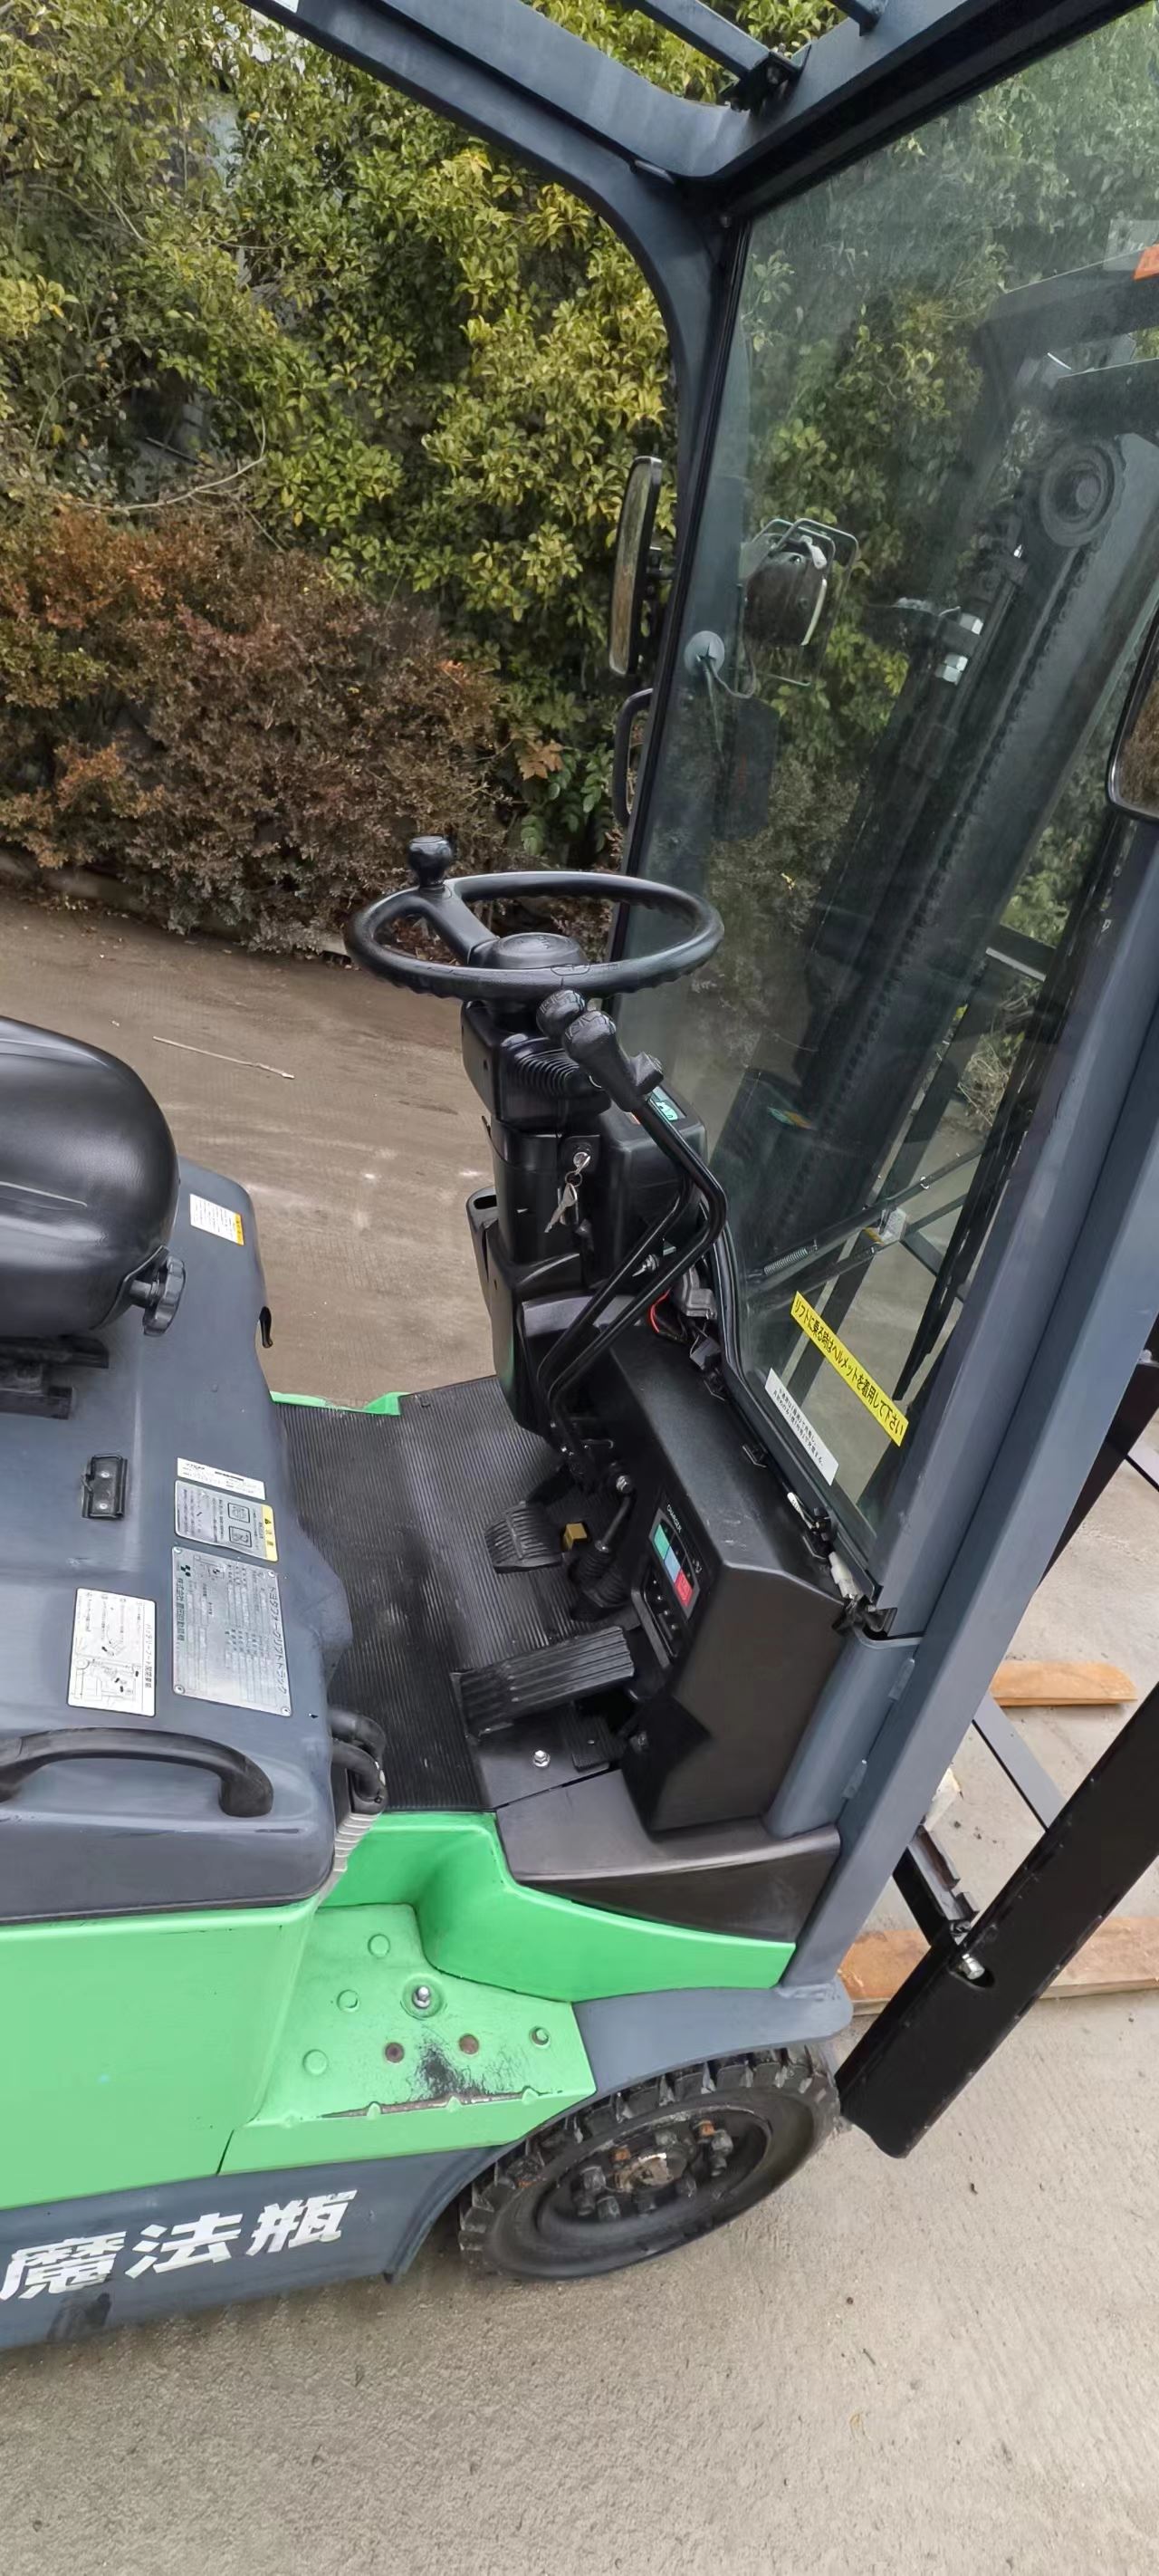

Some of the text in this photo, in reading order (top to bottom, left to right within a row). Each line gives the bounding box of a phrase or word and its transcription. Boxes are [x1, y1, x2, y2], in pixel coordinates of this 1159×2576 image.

[794, 1299, 905, 1436] リフトに乗る時はヘルメットを着用して下さい
[0, 2188, 359, 2301] 魔法瓶
